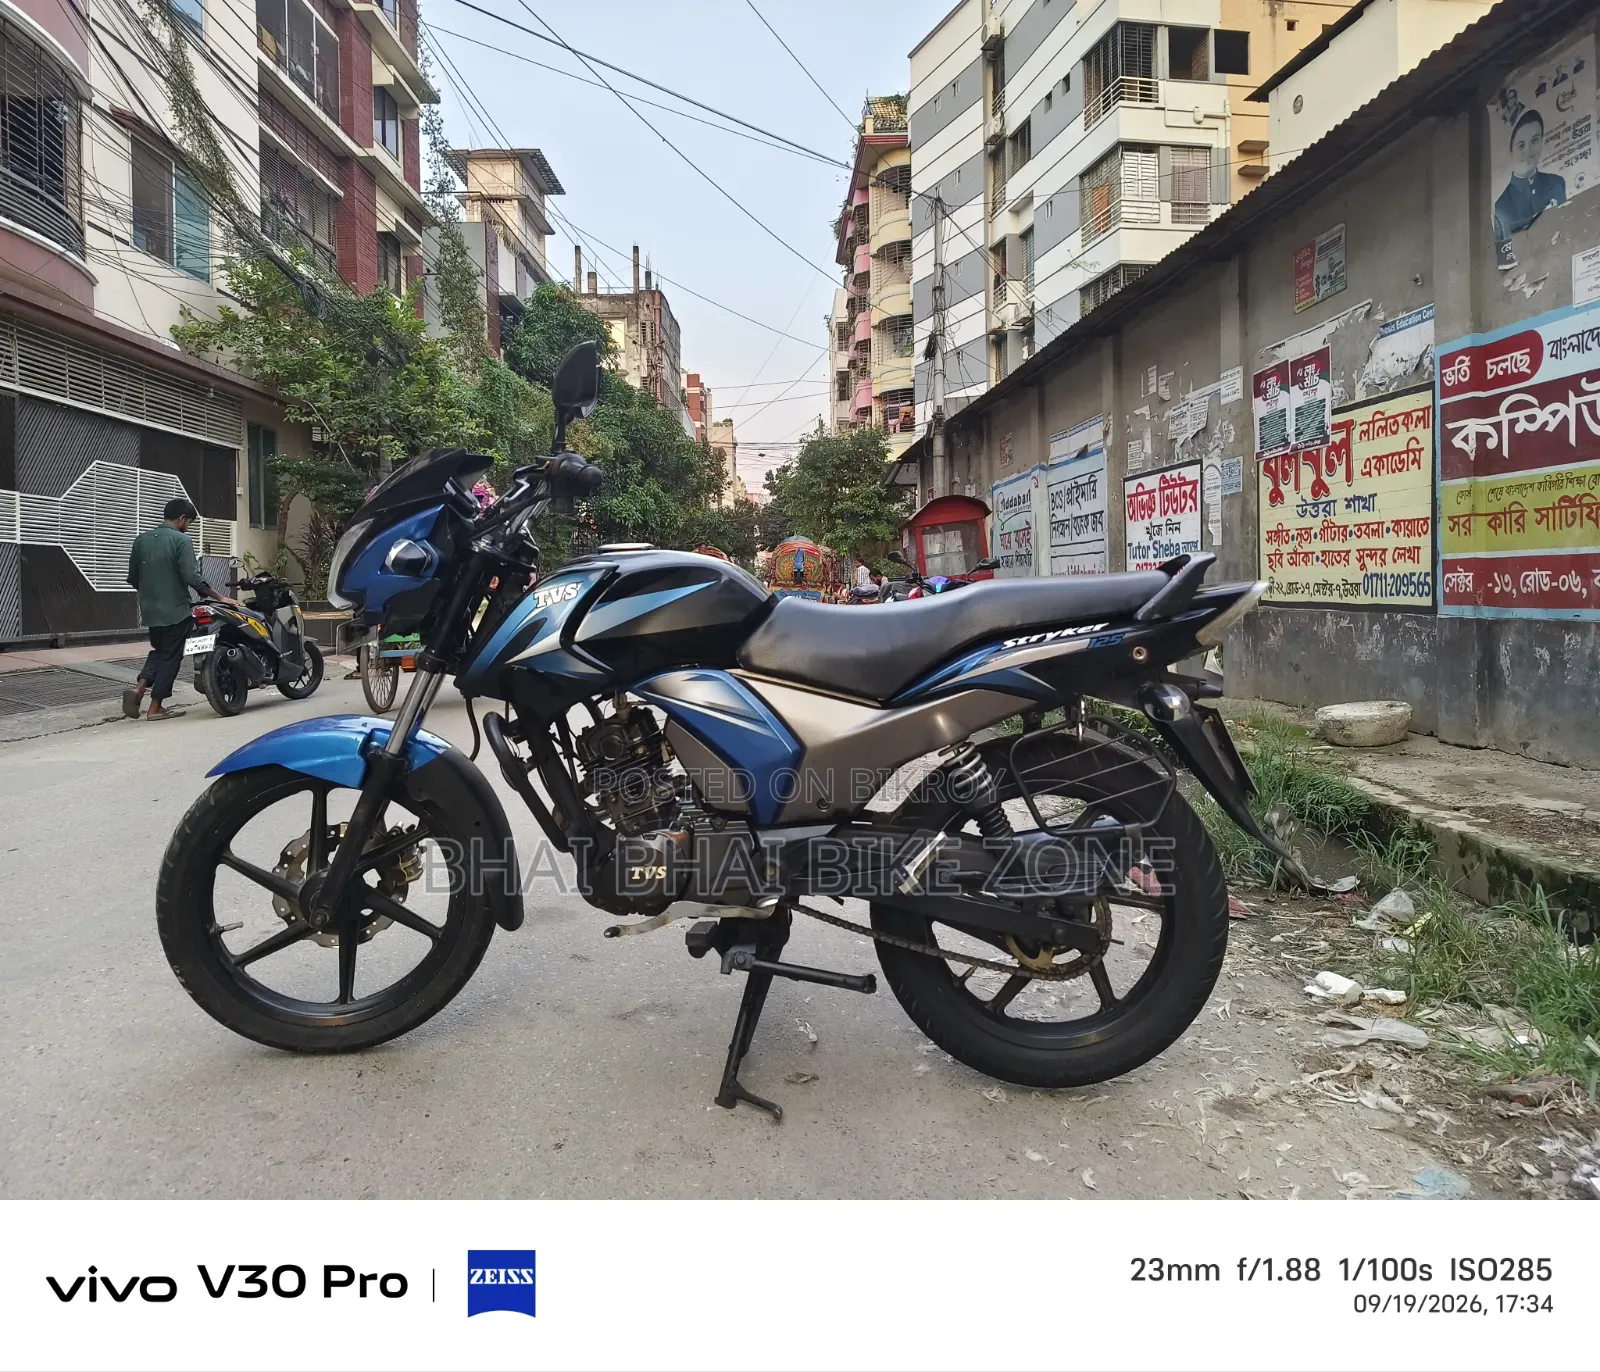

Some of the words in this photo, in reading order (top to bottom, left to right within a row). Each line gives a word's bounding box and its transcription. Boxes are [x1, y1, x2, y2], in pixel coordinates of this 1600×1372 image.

[1395, 313, 1422, 330] Education
[1547, 326, 1600, 361] বাংলাদে
[1442, 355, 1471, 387] ভর্তি
[1485, 348, 1532, 380] চলছে
[1445, 377, 1600, 461] কম্পিউ
[1262, 418, 1355, 507] বুলবুল
[1361, 436, 1425, 478] একাডেমি
[1127, 482, 1157, 522] অভিজ্ঞ
[1159, 472, 1199, 517] টিউটর
[1505, 480, 1535, 498] বাংলাদেশ
[1536, 473, 1564, 493] কারিগরি
[1563, 471, 1586, 489] শিক্ষা
[1587, 473, 1600, 491] বো
[1296, 495, 1337, 519] উত্তরা
[1344, 492, 1378, 514] শাখা
[1533, 492, 1600, 533] সার্টিফি
[1165, 518, 1181, 536] নিন
[1265, 522, 1291, 546] সঙ্গীত
[1295, 526, 1314, 549] নৃত্য
[1318, 518, 1349, 544] গীটার
[1353, 521, 1386, 540] তবলা
[1390, 516, 1430, 538] কারাতে
[1127, 542, 1151, 560] Tutor
[1151, 539, 1181, 559] Sheba
[1266, 548, 1284, 573] ছবি
[1287, 545, 1316, 567] আঁকা
[1319, 549, 1351, 569] হাতের
[1355, 547, 1388, 573] সুন্দর
[1391, 546, 1422, 565] লেখা
[1362, 571, 1431, 599] 01711-209565
[1443, 565, 1474, 593] সেক্টর
[533, 580, 585, 609] TVS
[1001, 622, 1110, 651] Stryker
[1087, 632, 1127, 651] 125
[630, 865, 668, 881] TVS
